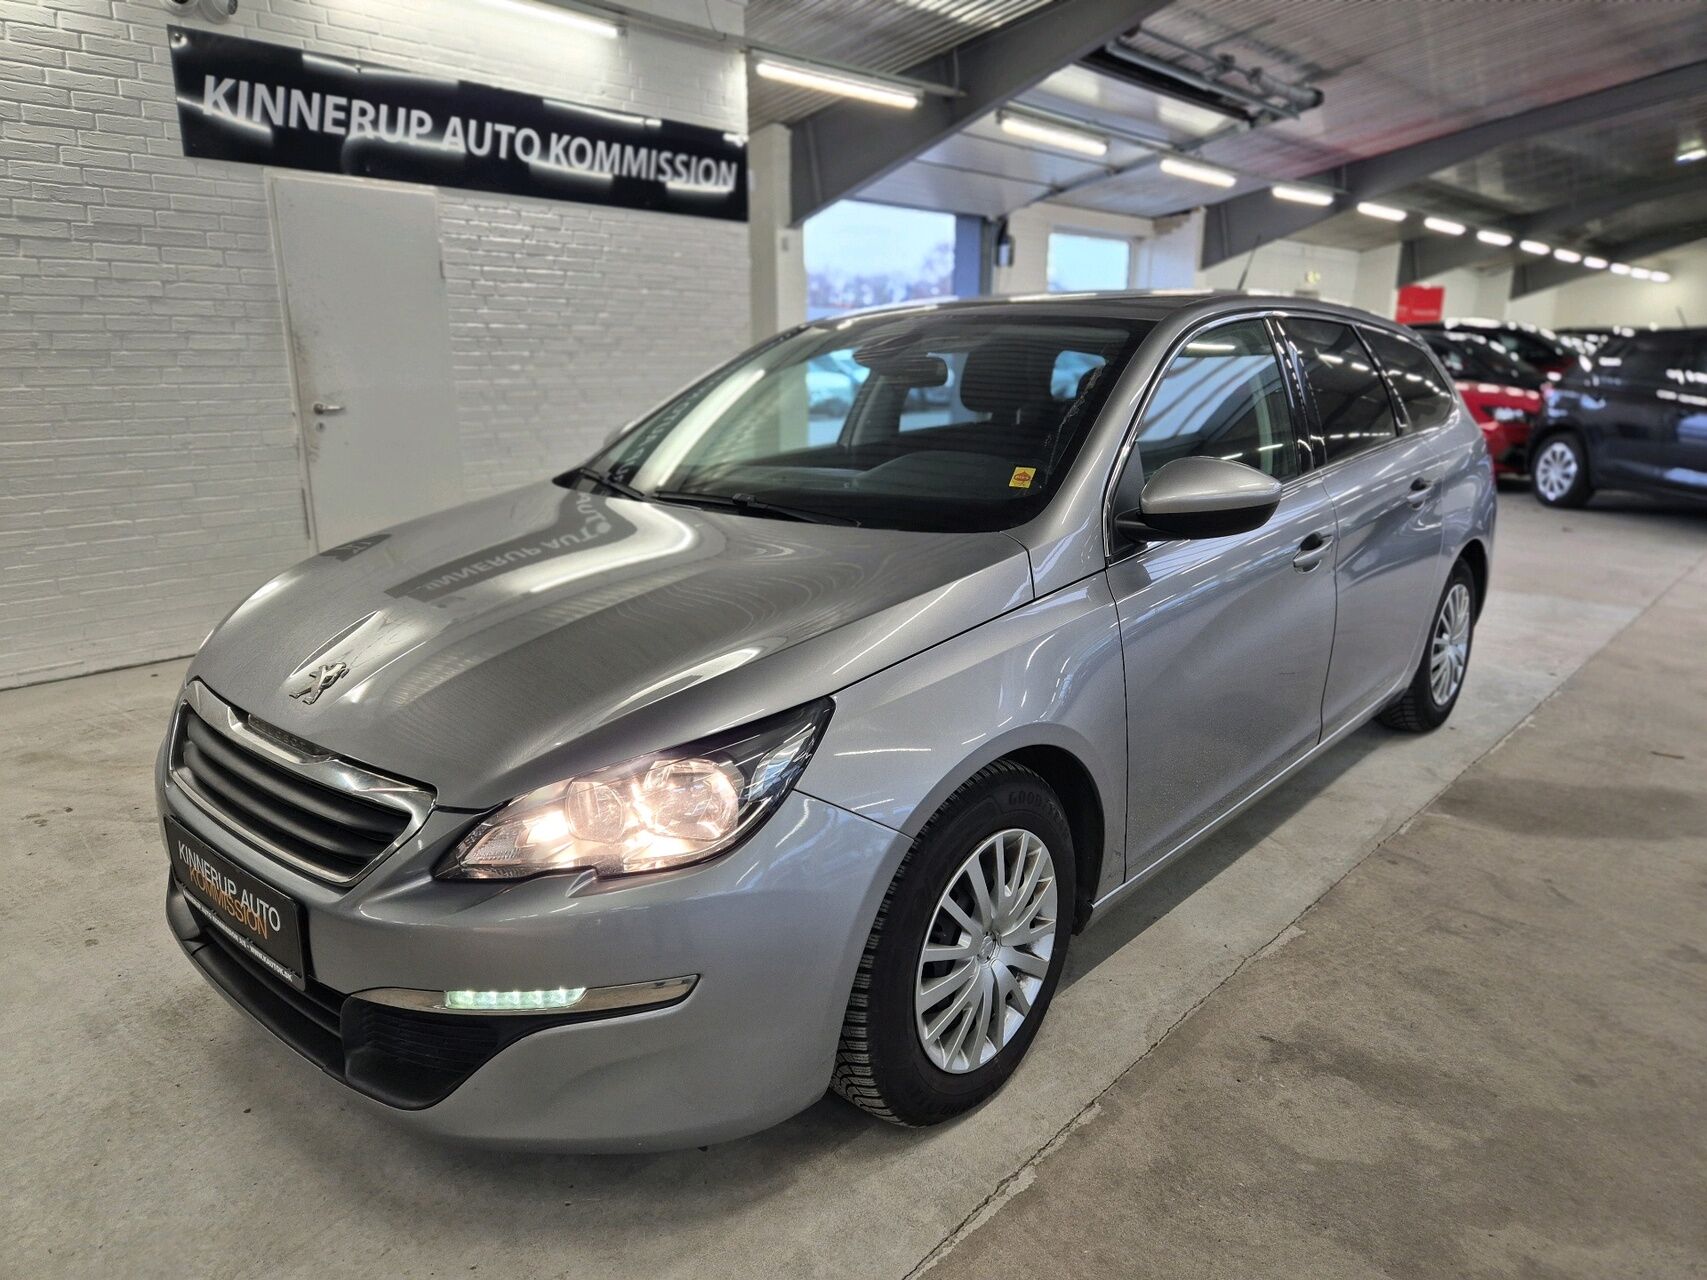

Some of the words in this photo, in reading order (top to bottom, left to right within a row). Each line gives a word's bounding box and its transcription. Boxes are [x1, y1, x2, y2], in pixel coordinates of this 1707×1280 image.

[203, 75, 433, 145] KINNERUP
[439, 116, 541, 163] AUTO
[549, 132, 737, 191] KOMMISSION
[178, 840, 237, 897] KINNERUP
[241, 888, 280, 932] AUTO
[189, 865, 268, 940] KOMMISSION
